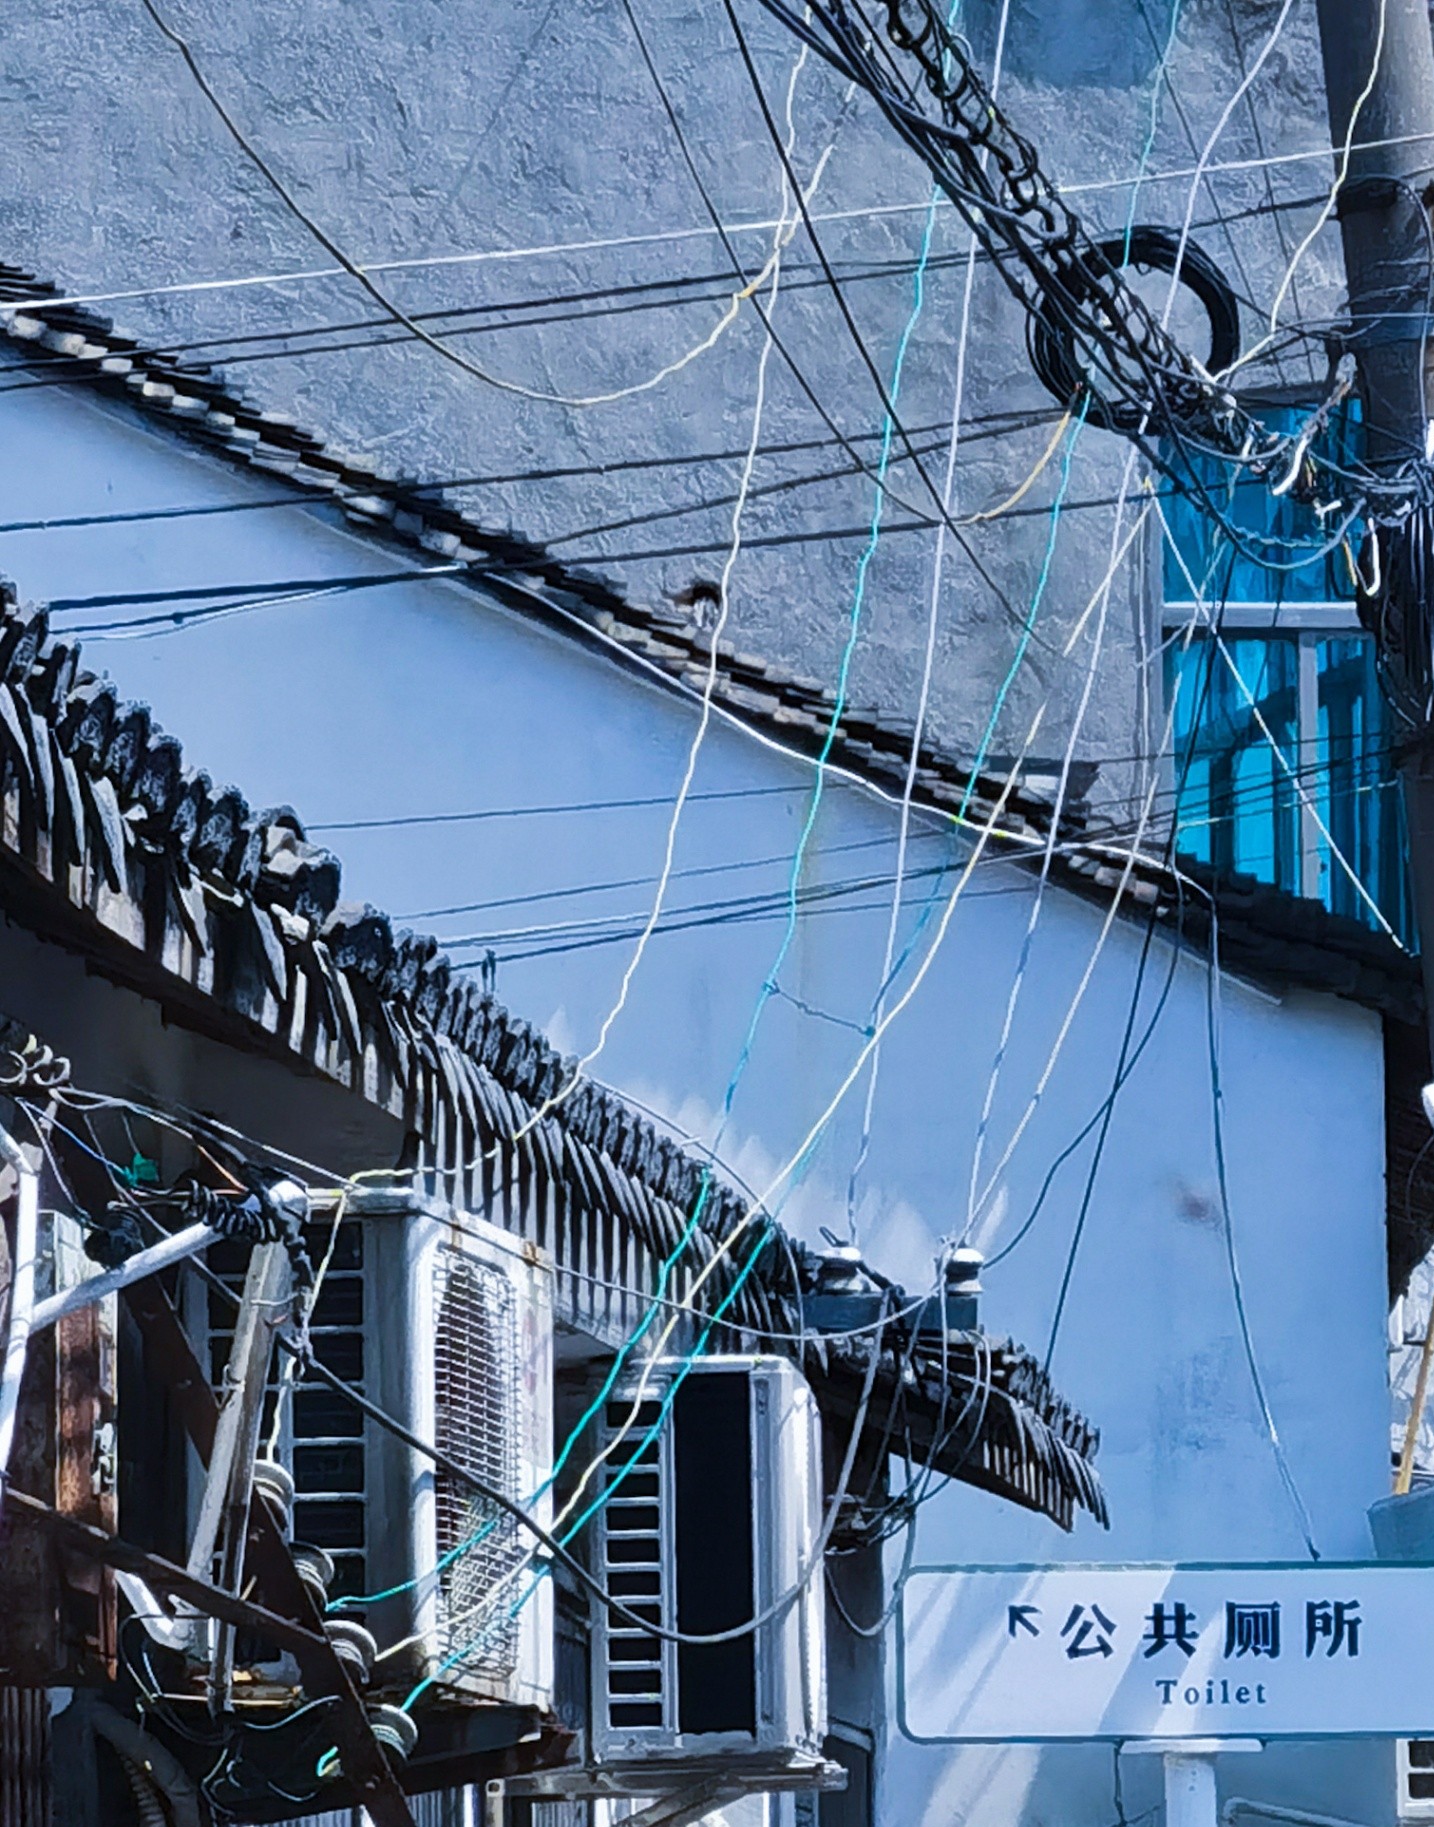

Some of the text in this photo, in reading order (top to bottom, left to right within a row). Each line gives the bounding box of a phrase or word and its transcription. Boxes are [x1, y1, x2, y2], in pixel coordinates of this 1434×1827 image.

[1060, 1600, 1365, 1659] 公共厕所
[1155, 1679, 1268, 1706] Toilet
